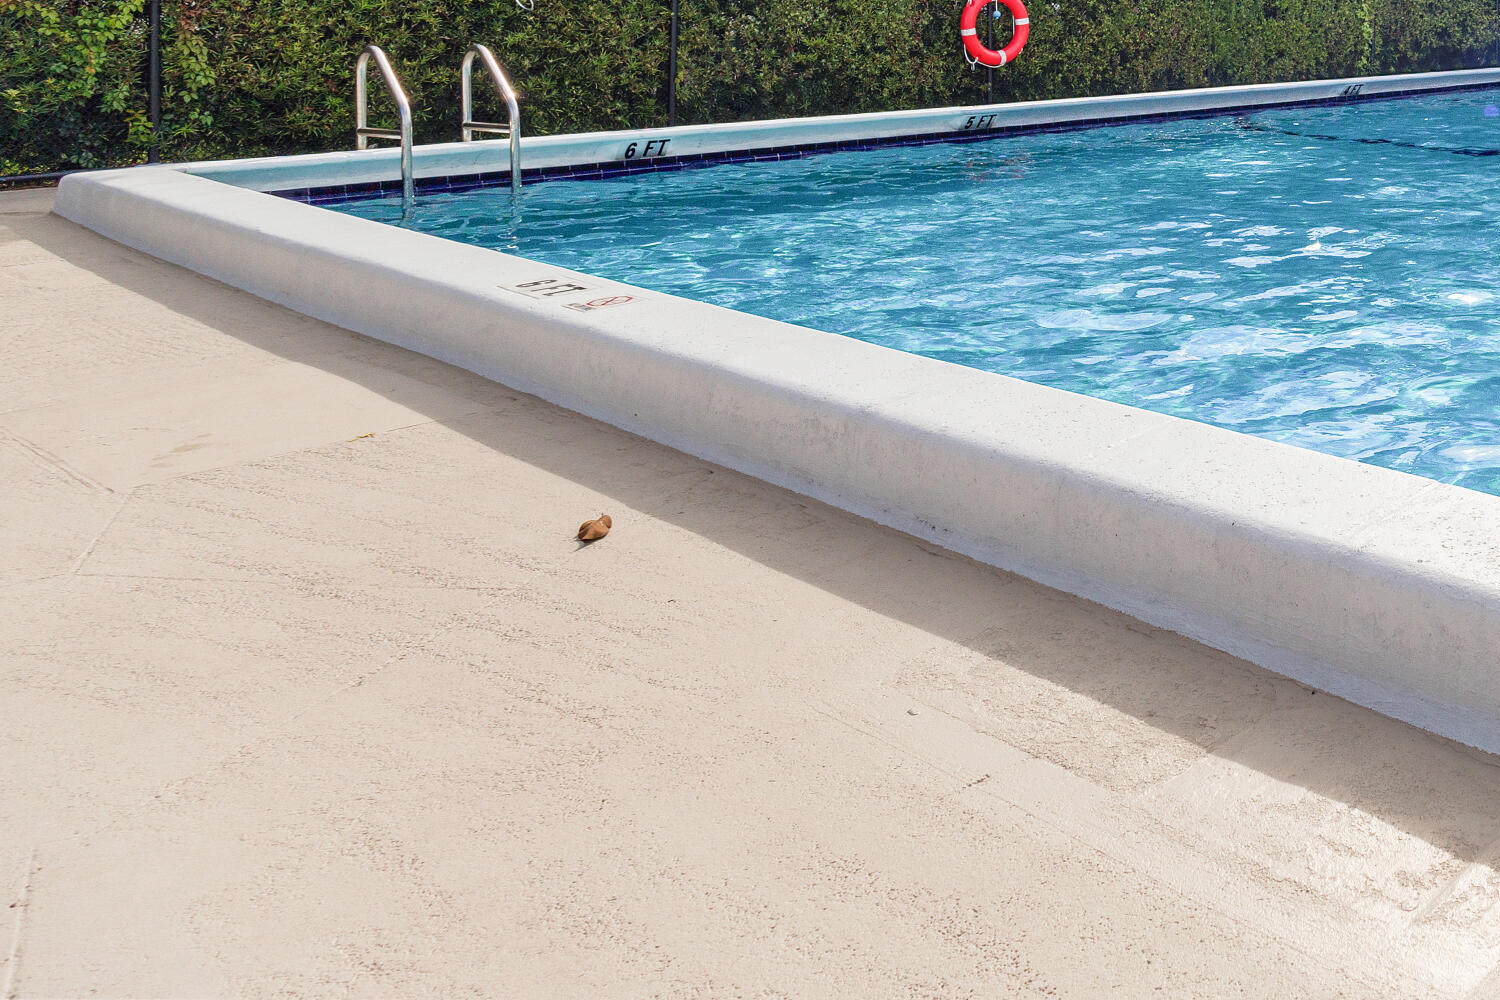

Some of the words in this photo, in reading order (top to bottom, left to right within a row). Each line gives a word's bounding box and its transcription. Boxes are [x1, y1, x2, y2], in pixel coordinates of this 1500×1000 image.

[964, 115, 976, 129] 5
[976, 114, 998, 128] FT
[624, 142, 638, 159] 6
[642, 138, 671, 157] FT
